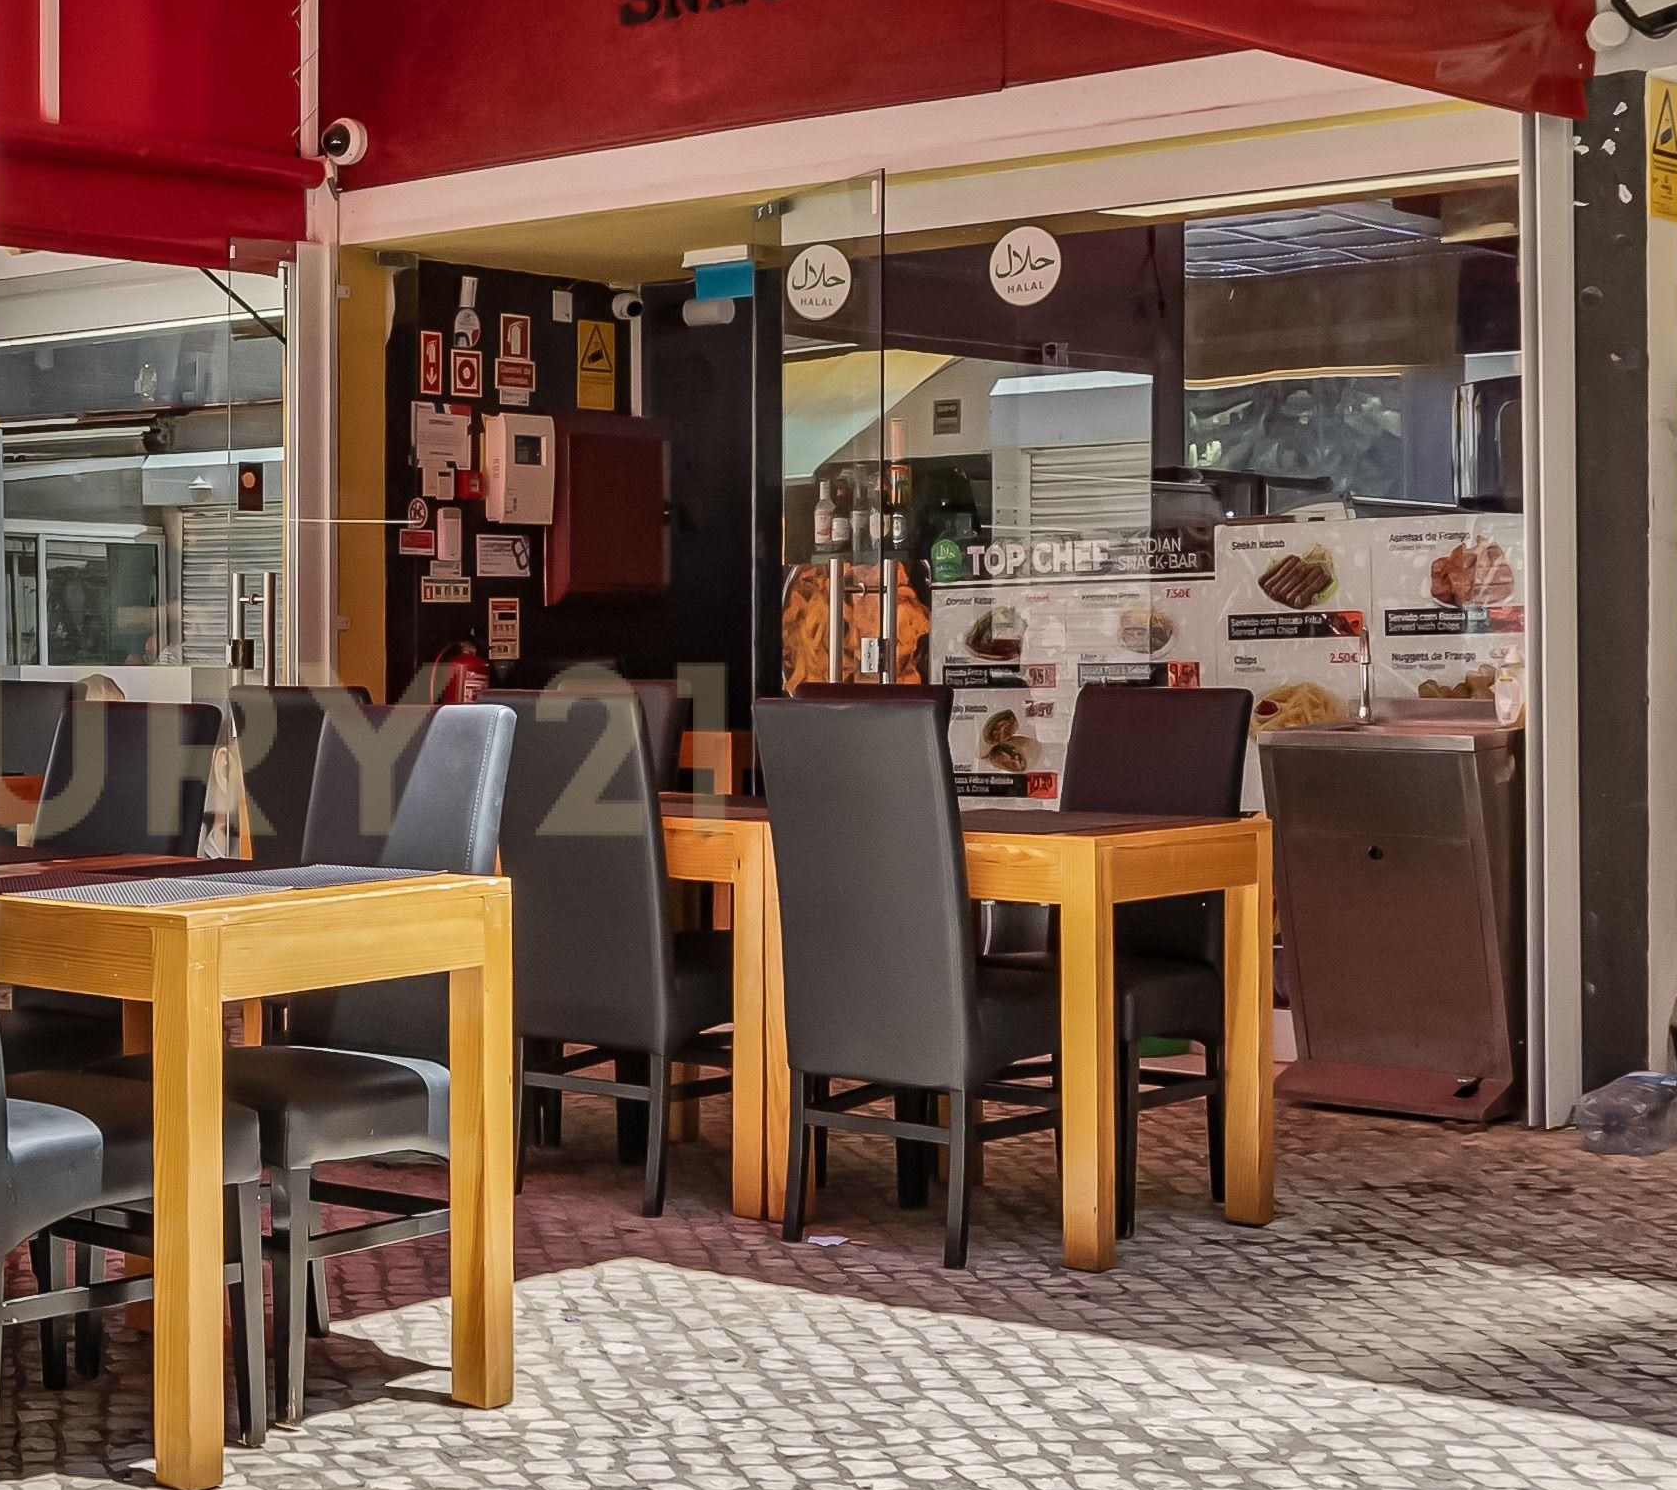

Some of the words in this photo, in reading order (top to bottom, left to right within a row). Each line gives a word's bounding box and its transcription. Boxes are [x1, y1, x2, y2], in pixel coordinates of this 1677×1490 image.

[995, 243, 1056, 279] حلال
[791, 258, 846, 290] حلال
[1006, 281, 1045, 294] HALAL
[800, 297, 834, 307] HALAL
[1133, 537, 1182, 553] INDIAN
[967, 545, 1026, 576] TOP
[1031, 538, 1109, 574] CHEF
[1117, 553, 1198, 572] SNACK-BAR
[1329, 652, 1359, 664] 2.50€
